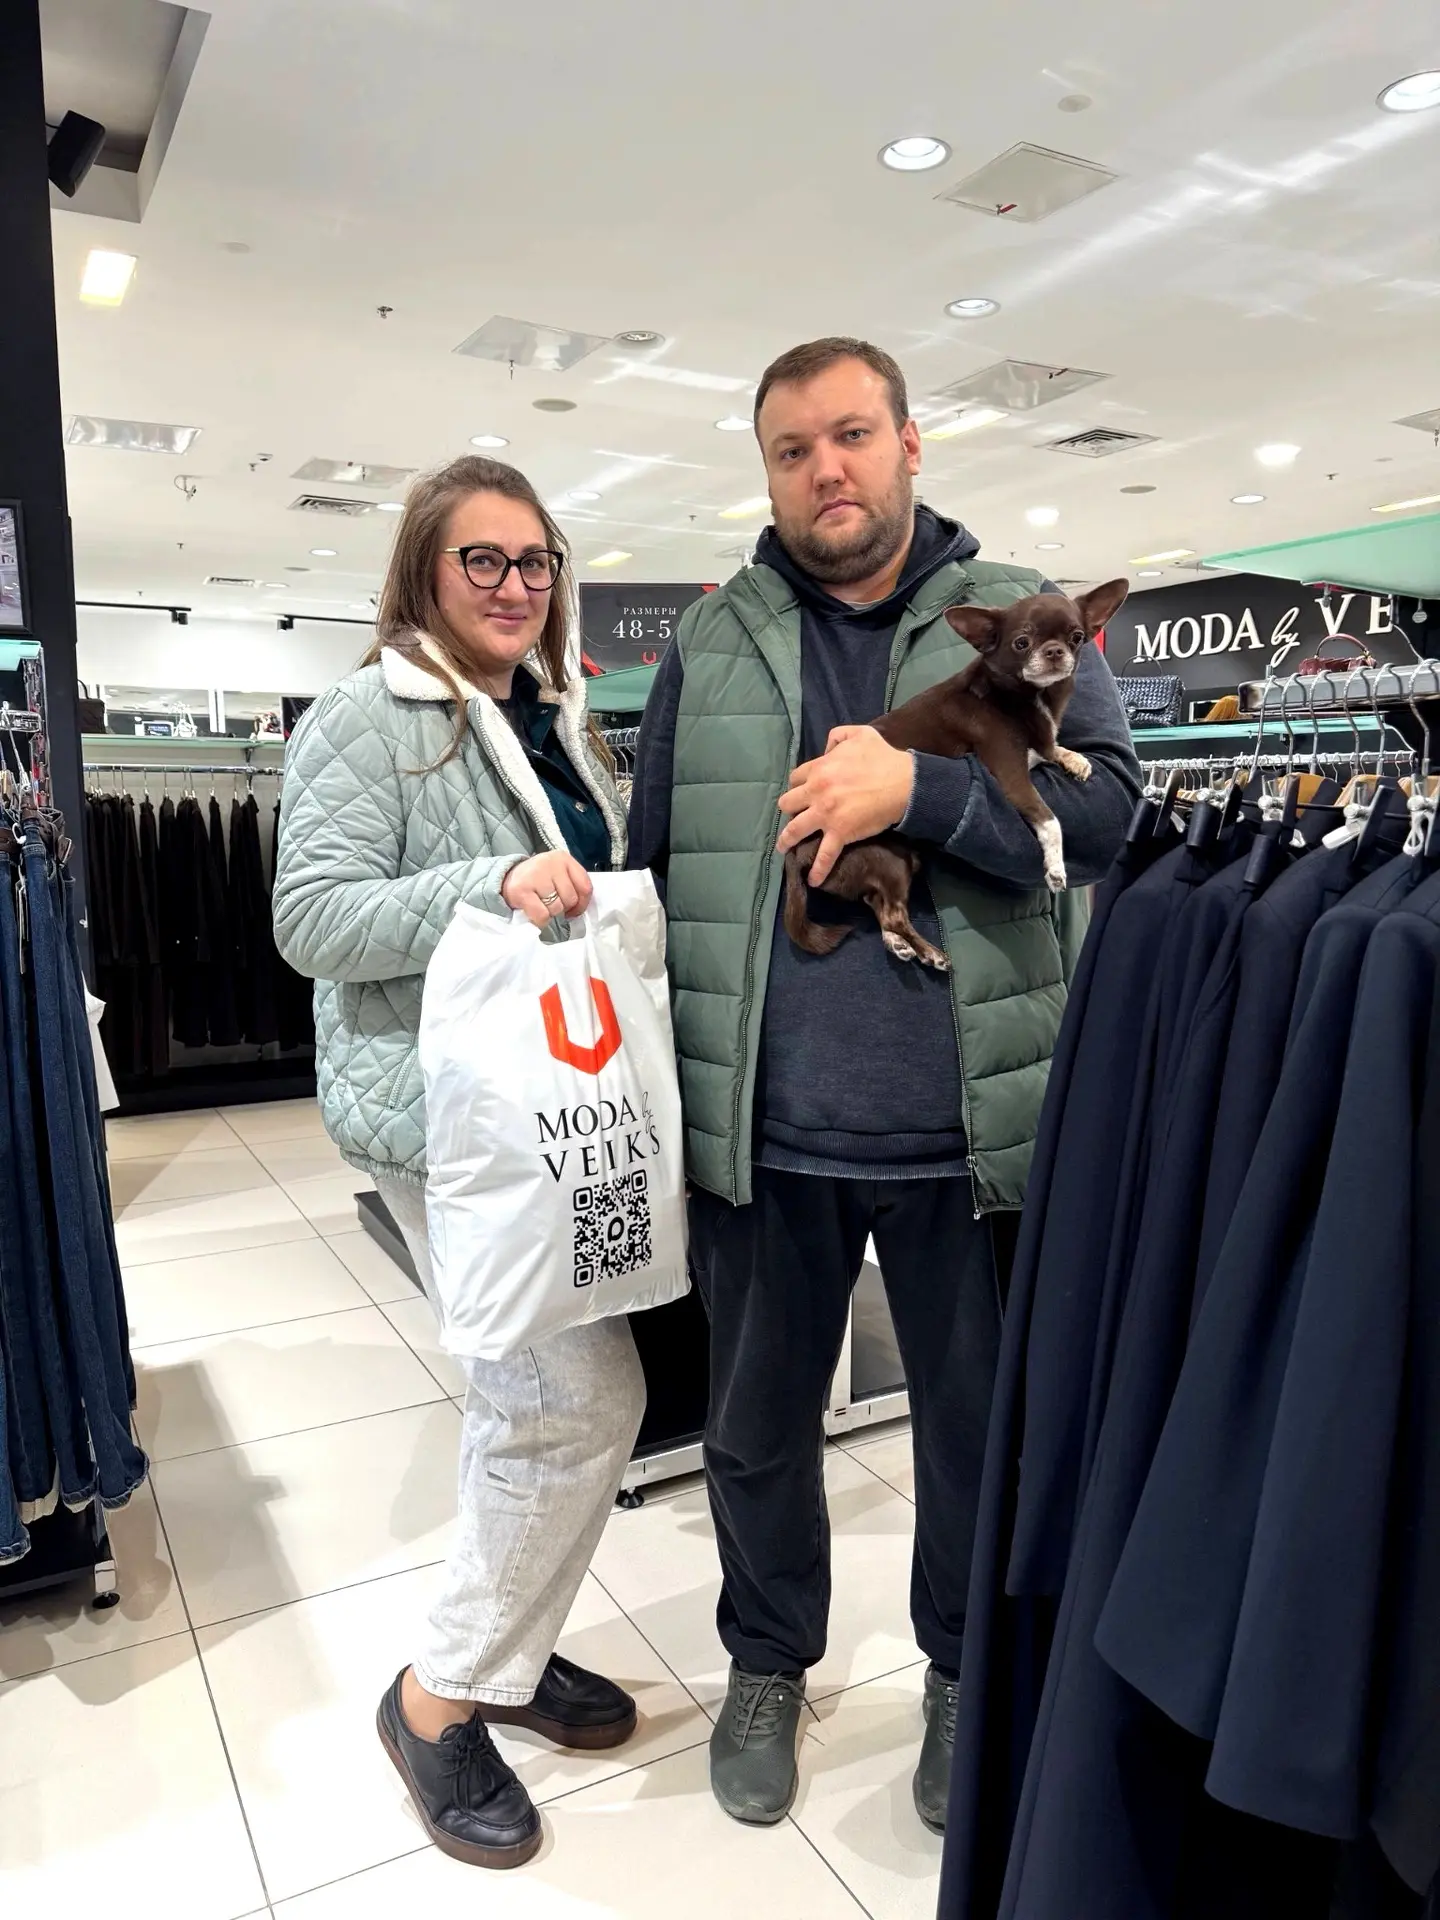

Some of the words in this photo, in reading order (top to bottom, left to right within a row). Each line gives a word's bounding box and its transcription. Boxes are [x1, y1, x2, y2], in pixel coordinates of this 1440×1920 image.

[612, 619, 671, 639] 48-5
[623, 607, 677, 616] РАЗМЕРЫ
[1133, 607, 1265, 663] MODA
[1270, 606, 1301, 668] by
[1315, 593, 1394, 636] VE
[533, 1094, 639, 1144] MODA
[641, 1091, 654, 1134] by
